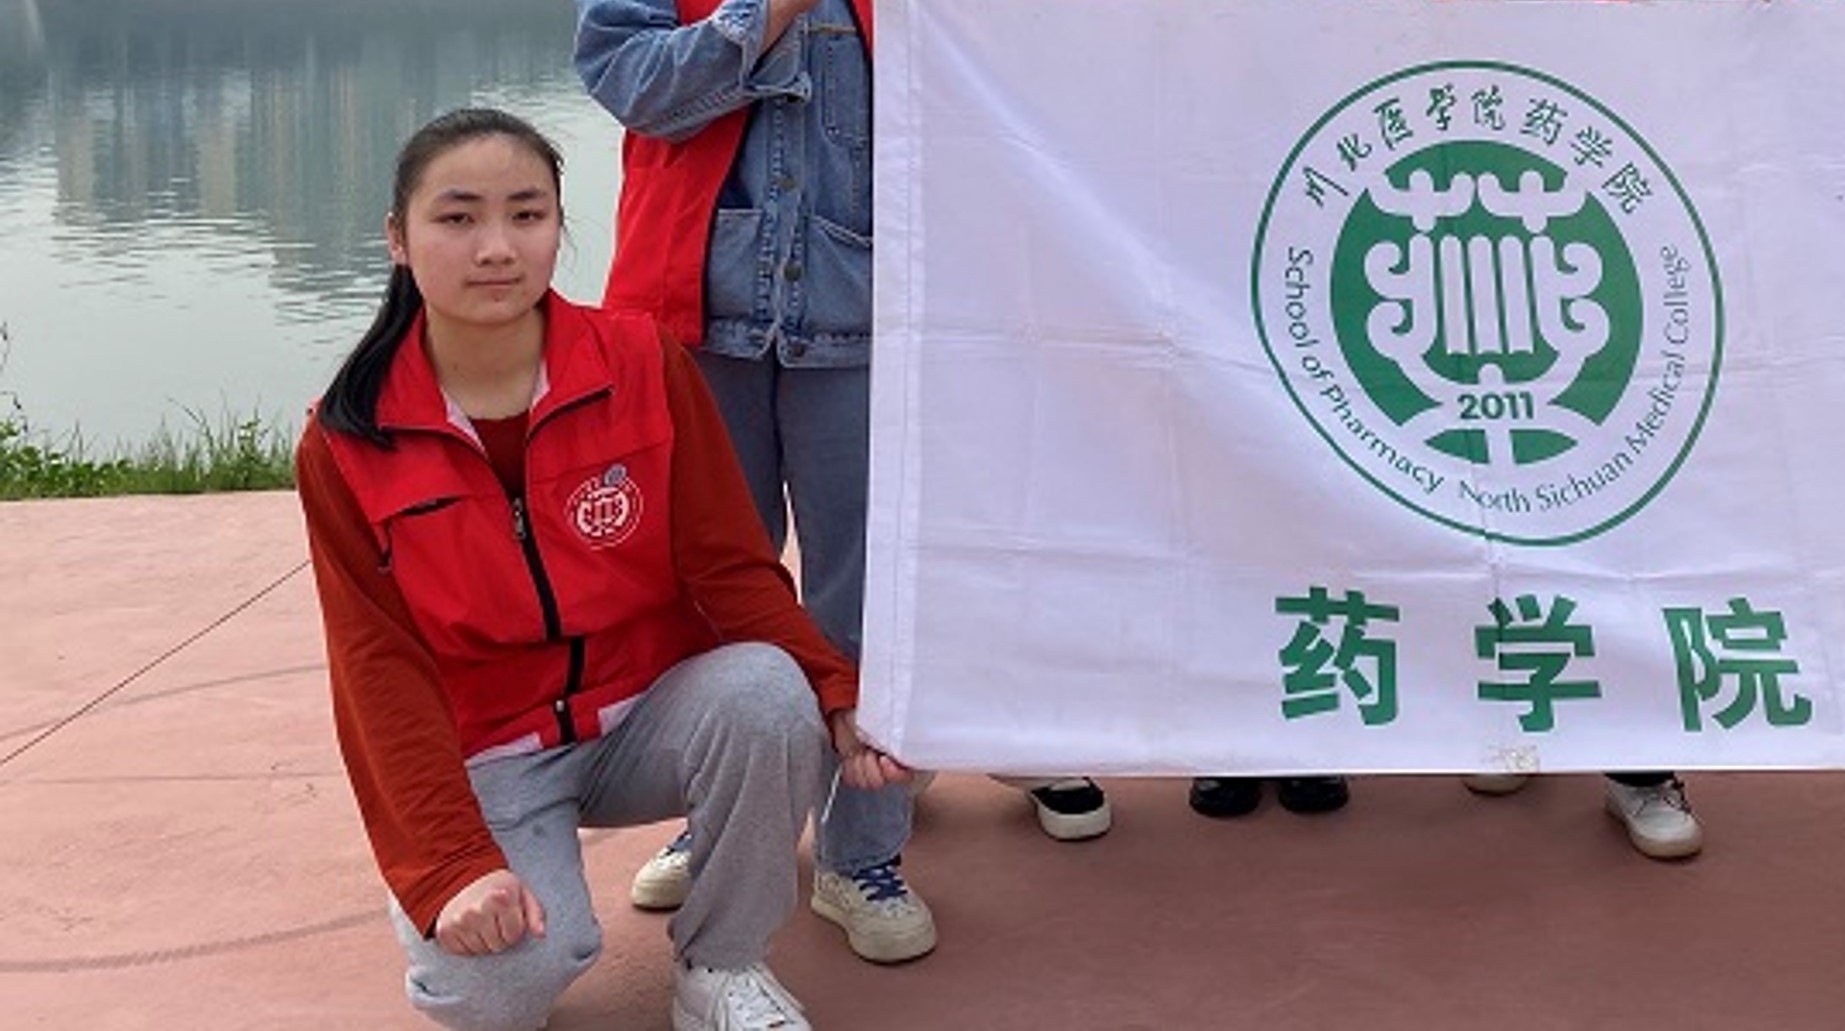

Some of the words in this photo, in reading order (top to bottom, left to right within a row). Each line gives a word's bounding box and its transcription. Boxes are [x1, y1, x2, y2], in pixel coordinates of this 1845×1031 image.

[1285, 245, 1318, 350] School
[1663, 245, 1691, 346] College
[1301, 355, 1333, 383] of
[1457, 393, 1534, 422] 2011
[1627, 351, 1686, 454] Medical
[1321, 382, 1445, 495] Pharmacy
[1535, 447, 1636, 511] Sichuan
[1457, 479, 1532, 514] North
[1275, 586, 1814, 733] 药学院
